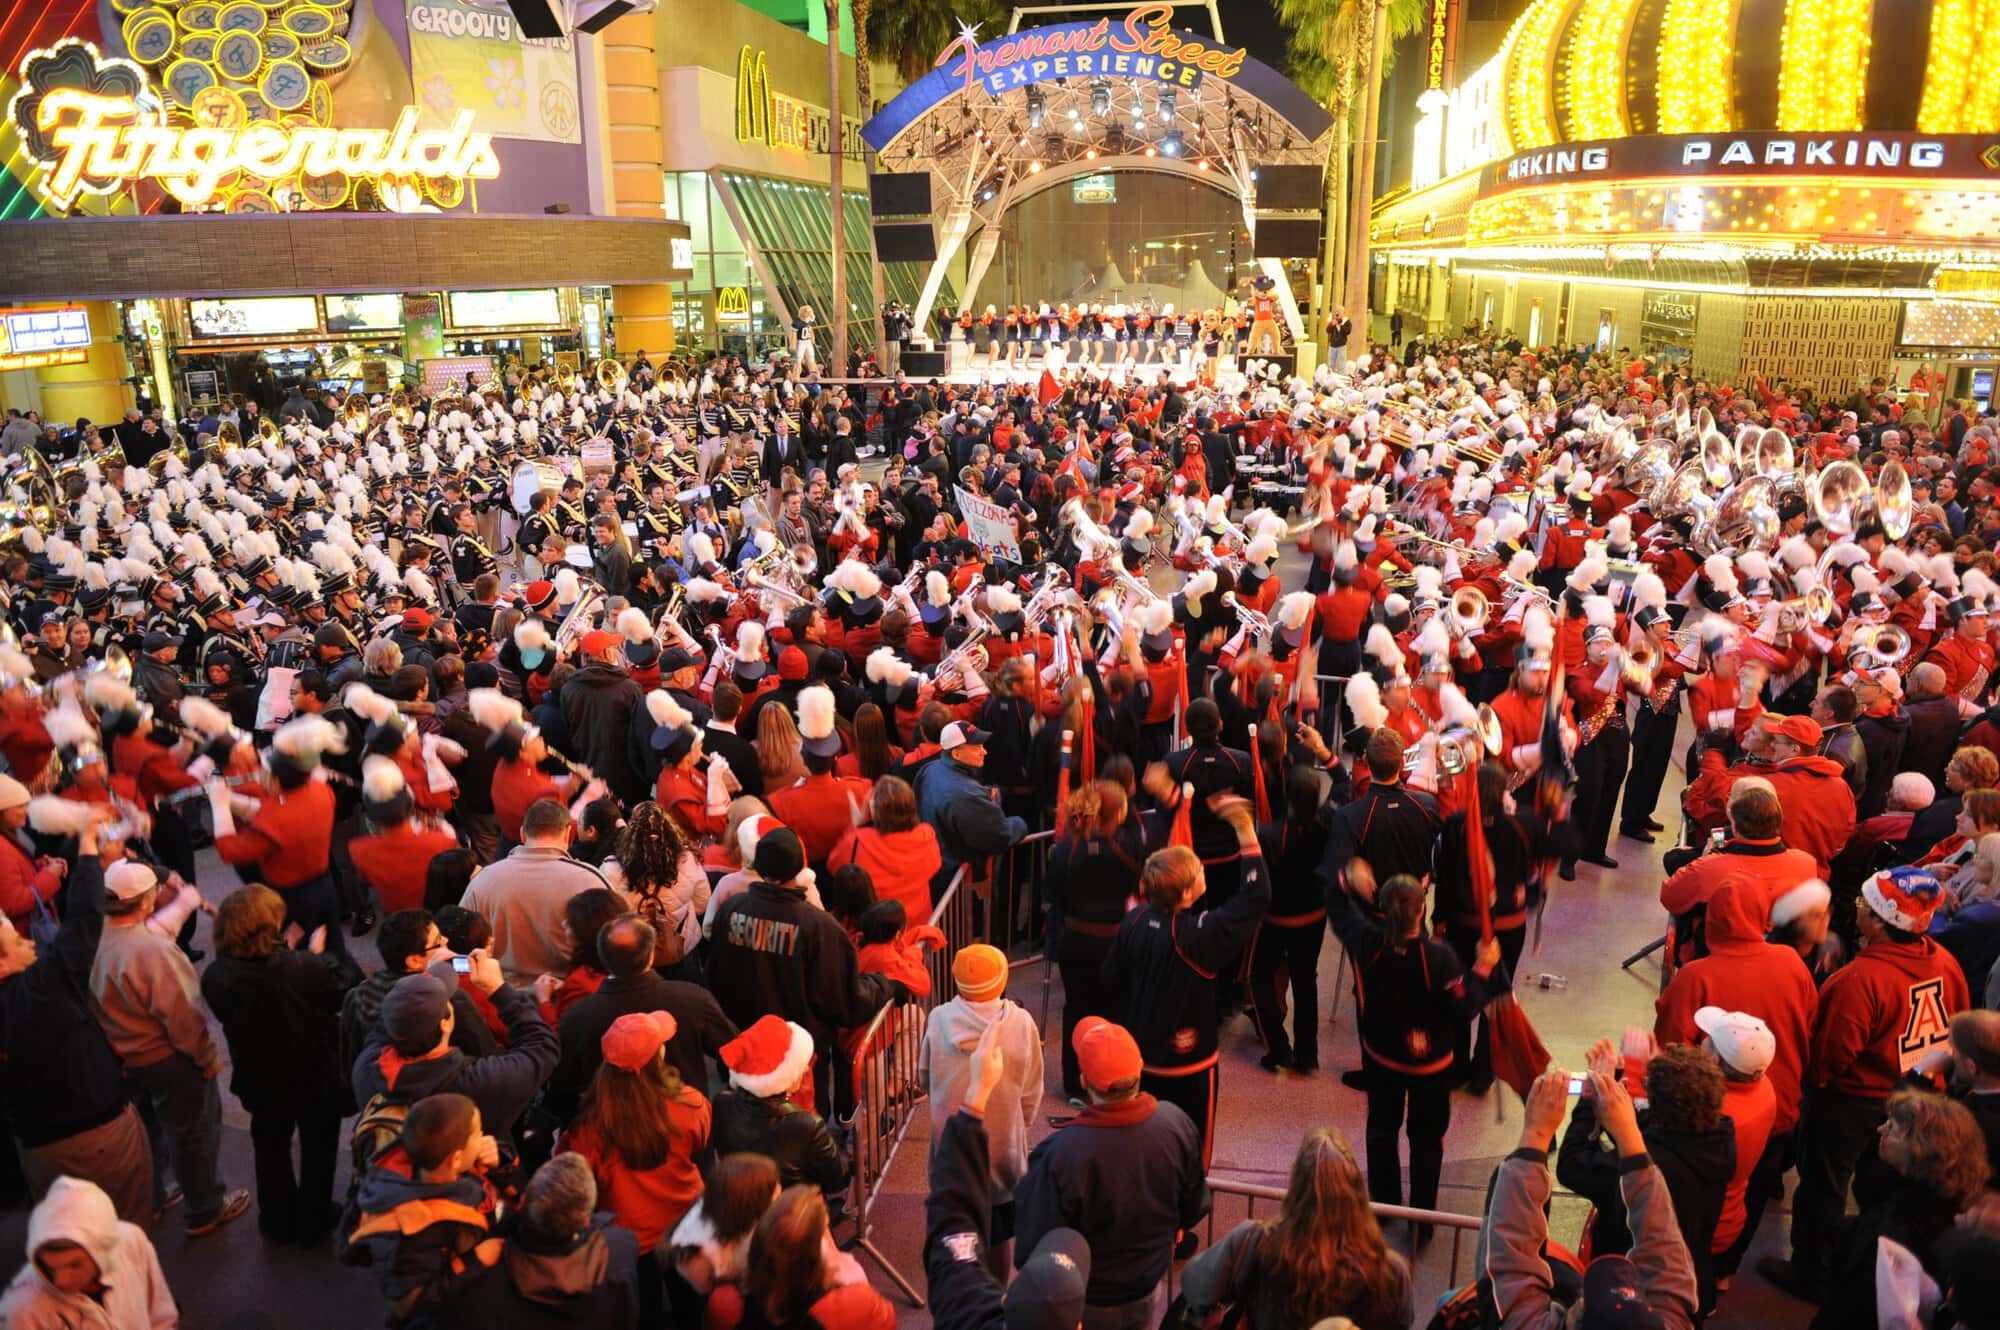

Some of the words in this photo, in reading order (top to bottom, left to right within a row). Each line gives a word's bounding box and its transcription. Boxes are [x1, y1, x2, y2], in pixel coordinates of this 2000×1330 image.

[411, 6, 511, 41] GROOVY
[935, 16, 1110, 96] Fremont
[1110, 4, 1247, 78] Street
[990, 54, 1198, 91] EXPERIENCE
[37, 87, 501, 204] Fitzgeralds
[1507, 147, 1609, 180] PARKING
[1682, 140, 1945, 168] PARKING
[728, 911, 800, 956] SECURITY
[1900, 977, 1950, 1054] A
